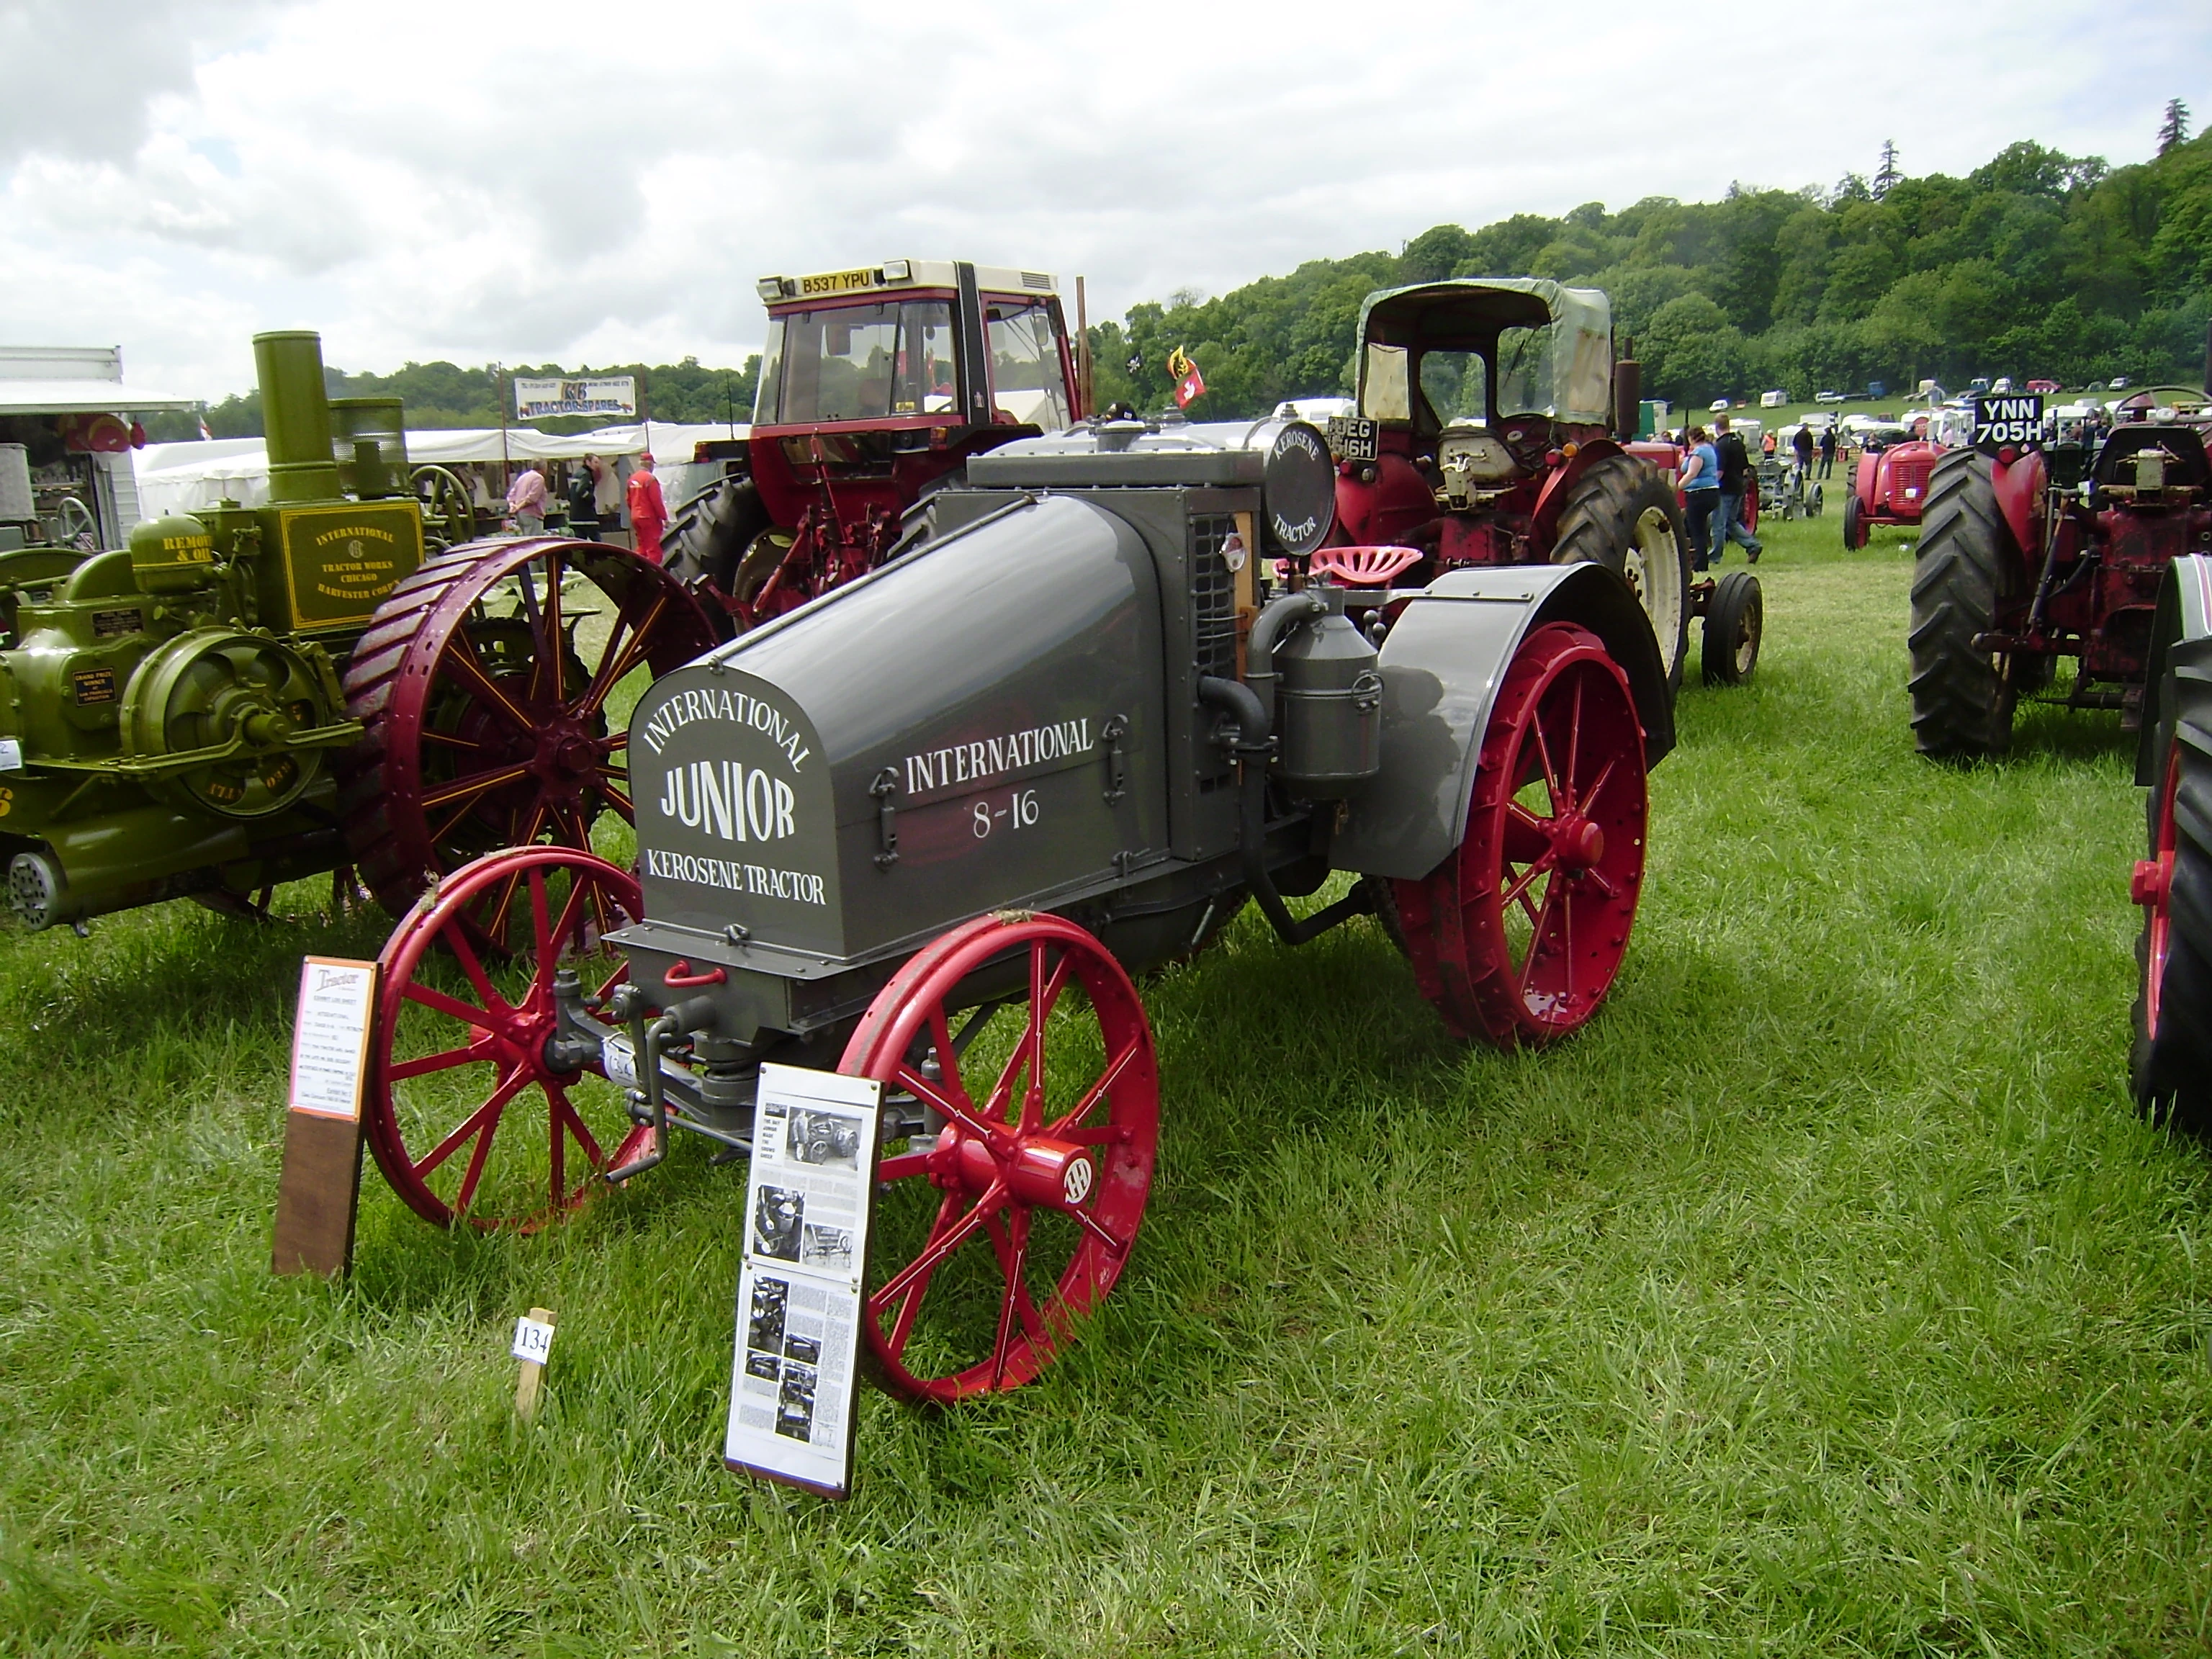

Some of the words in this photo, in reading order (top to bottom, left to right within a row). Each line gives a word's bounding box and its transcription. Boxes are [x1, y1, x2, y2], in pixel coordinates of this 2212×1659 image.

[803, 276, 837, 293] B537
[842, 272, 870, 288] YPU
[527, 400, 578, 415] TRACTOR
[580, 399, 620, 413] SPARES
[1984, 399, 2034, 420] YNN
[1977, 421, 2042, 443] 705H
[1274, 431, 1319, 461] KEROSENE
[316, 527, 393, 546] INTERNATIONAL
[1274, 514, 1316, 541] TRACTOR
[323, 562, 361, 572] TRACTOR
[364, 561, 393, 570] WORKS
[341, 573, 377, 583] CHICAGO
[318, 583, 369, 599] HARVESTER
[643, 689, 810, 773] INTERNATIONAL
[906, 718, 1094, 794] INTERNATIONAL
[661, 760, 794, 842] JUNIOR
[974, 789, 1039, 838] 8-16
[647, 849, 742, 891] KEROSENE
[744, 864, 826, 905] TRACTOR
[521, 1327, 549, 1353] 134
